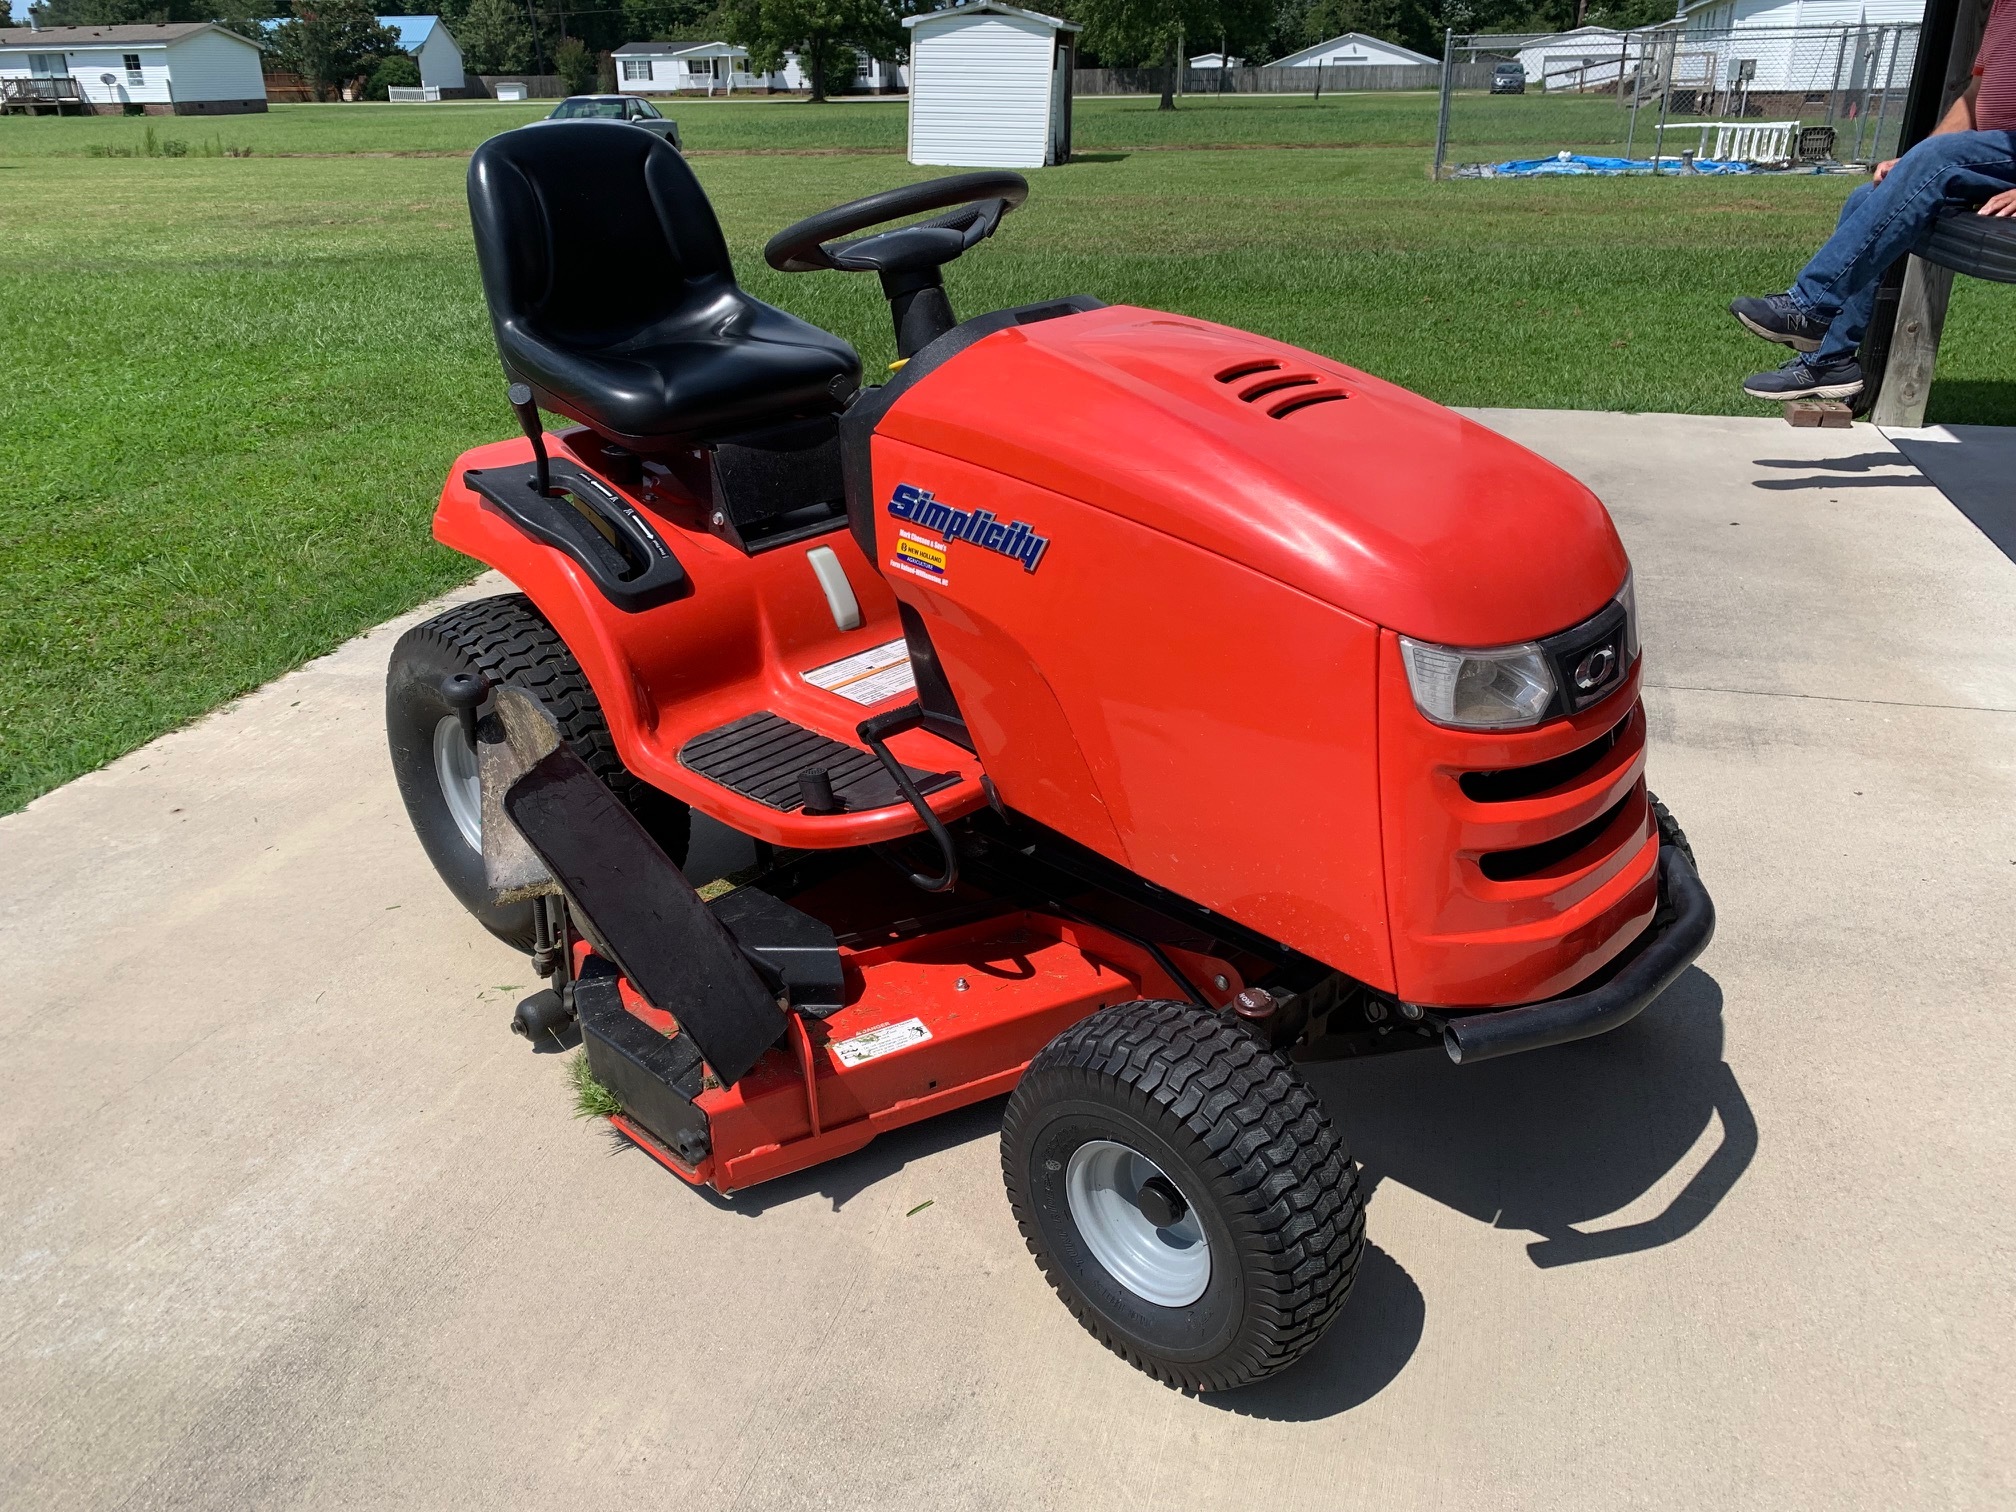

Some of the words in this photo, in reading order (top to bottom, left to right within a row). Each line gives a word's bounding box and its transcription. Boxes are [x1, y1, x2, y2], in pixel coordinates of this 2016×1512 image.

[1793, 369, 1815, 385] N
[887, 483, 1050, 572] Simplicity
[908, 547, 920, 556] NEW
[920, 550, 941, 563] HOLLAND
[906, 557, 934, 571] AGRICULTURE
